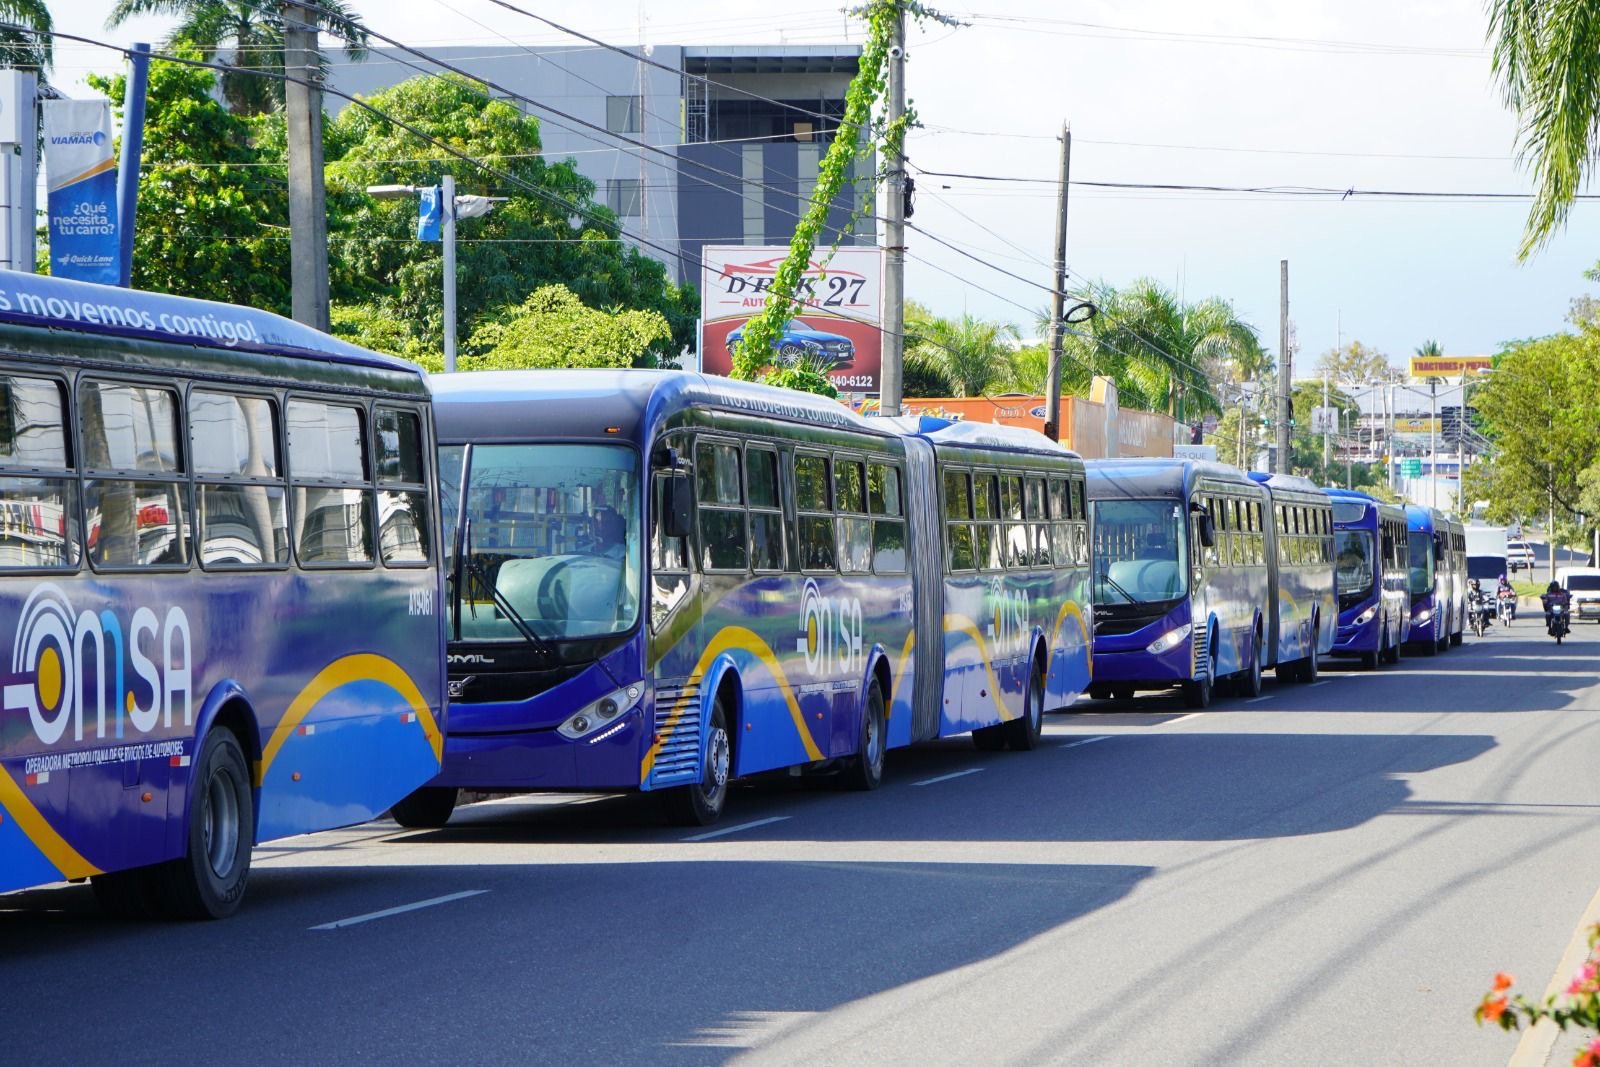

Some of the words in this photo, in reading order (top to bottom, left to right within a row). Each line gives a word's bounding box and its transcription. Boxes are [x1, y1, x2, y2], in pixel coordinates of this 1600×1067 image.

[51, 136, 93, 144] VIAMAR
[74, 201, 107, 215] ¿Qué
[53, 214, 108, 225] necesita
[59, 225, 74, 235] tu
[76, 223, 115, 235] carro?
[70, 255, 93, 263] Quick
[823, 276, 866, 307] 27
[742, 297, 771, 307] AUT
[16, 292, 156, 330] movemos
[160, 313, 261, 346] contigo!
[25, 755, 62, 774] OPERADORA
